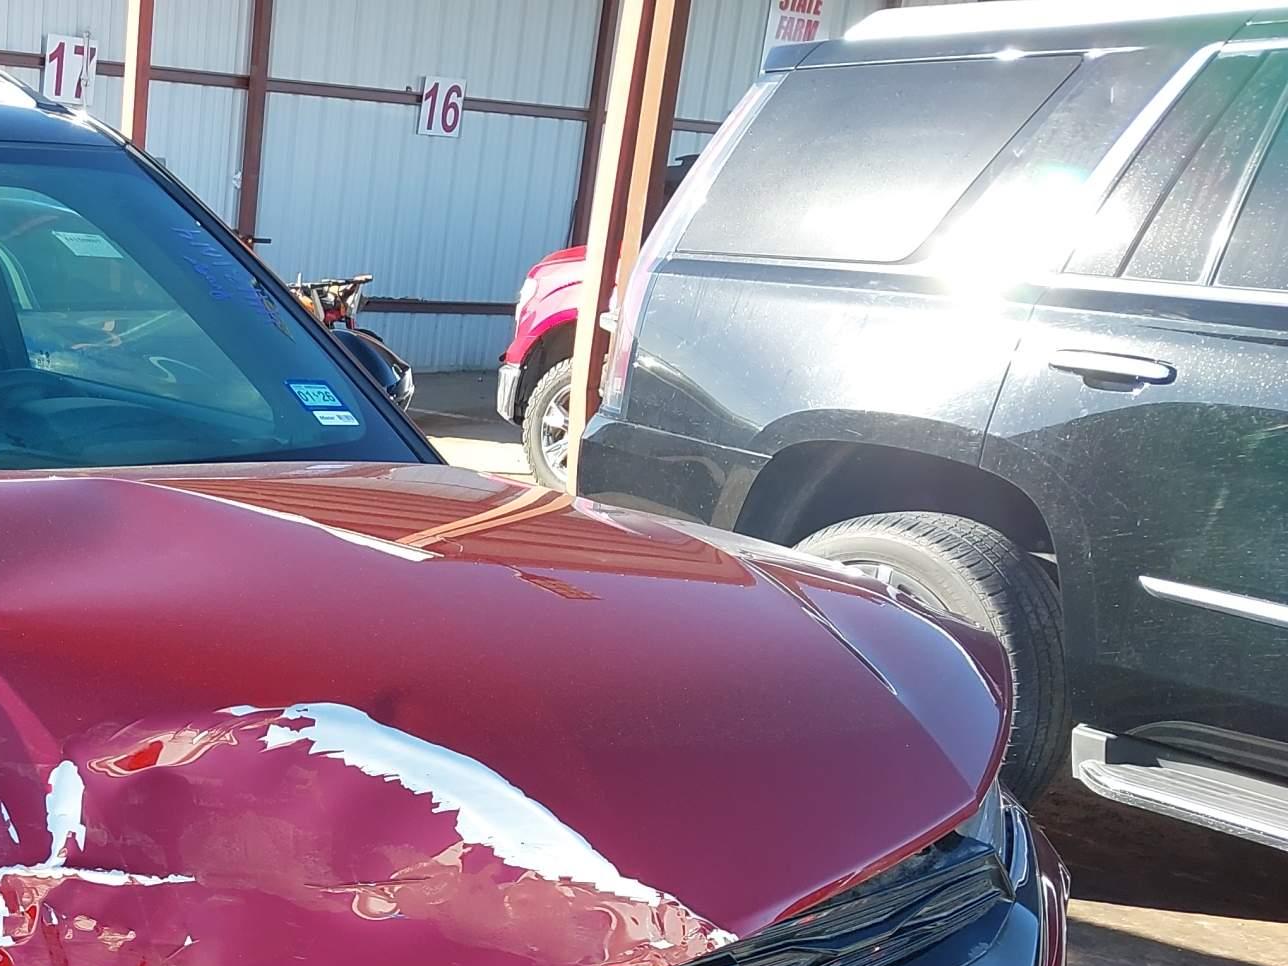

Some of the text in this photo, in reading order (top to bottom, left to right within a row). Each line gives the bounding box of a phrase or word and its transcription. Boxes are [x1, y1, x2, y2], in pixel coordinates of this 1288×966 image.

[775, 15, 819, 42] FARM
[49, 42, 97, 98] 17
[424, 82, 462, 133] 16
